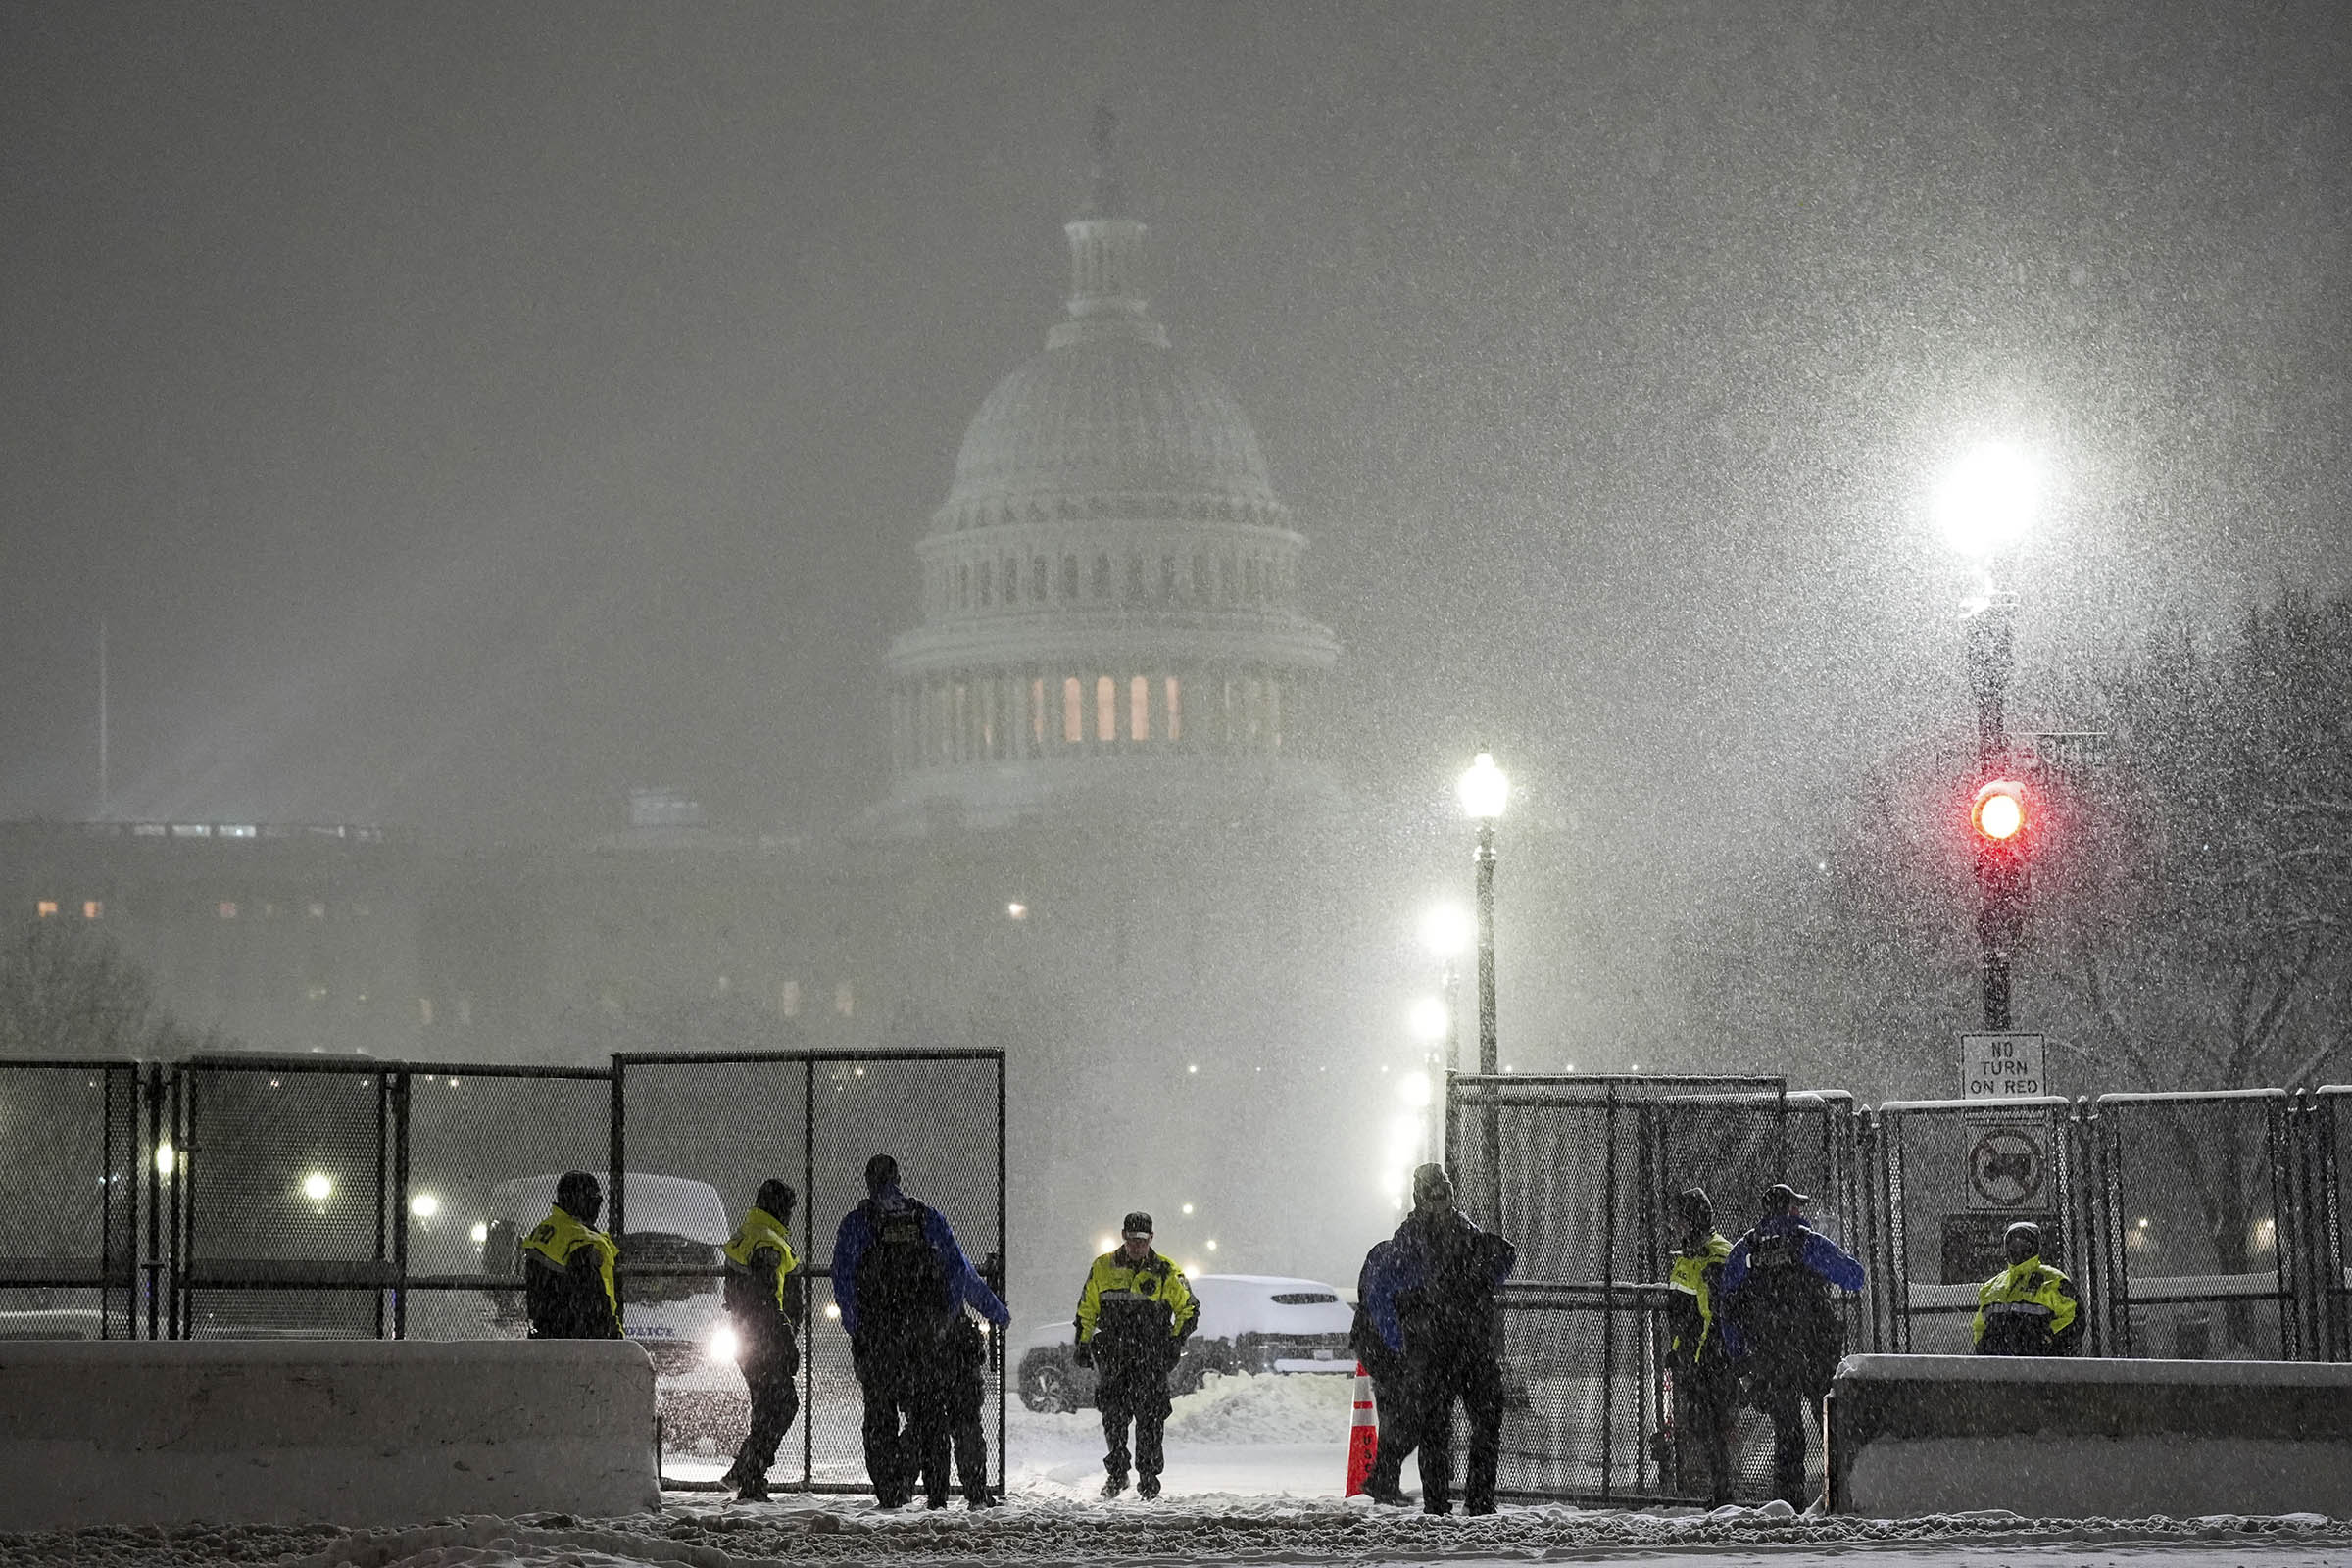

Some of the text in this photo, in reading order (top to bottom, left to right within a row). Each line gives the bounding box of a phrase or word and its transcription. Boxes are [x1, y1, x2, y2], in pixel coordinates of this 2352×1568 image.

[1991, 1041, 2013, 1058] NO
[1981, 1060, 2028, 1075] TURN
[1970, 1079, 2038, 1094] ON RED
[625, 1326, 675, 1337] OLICE
